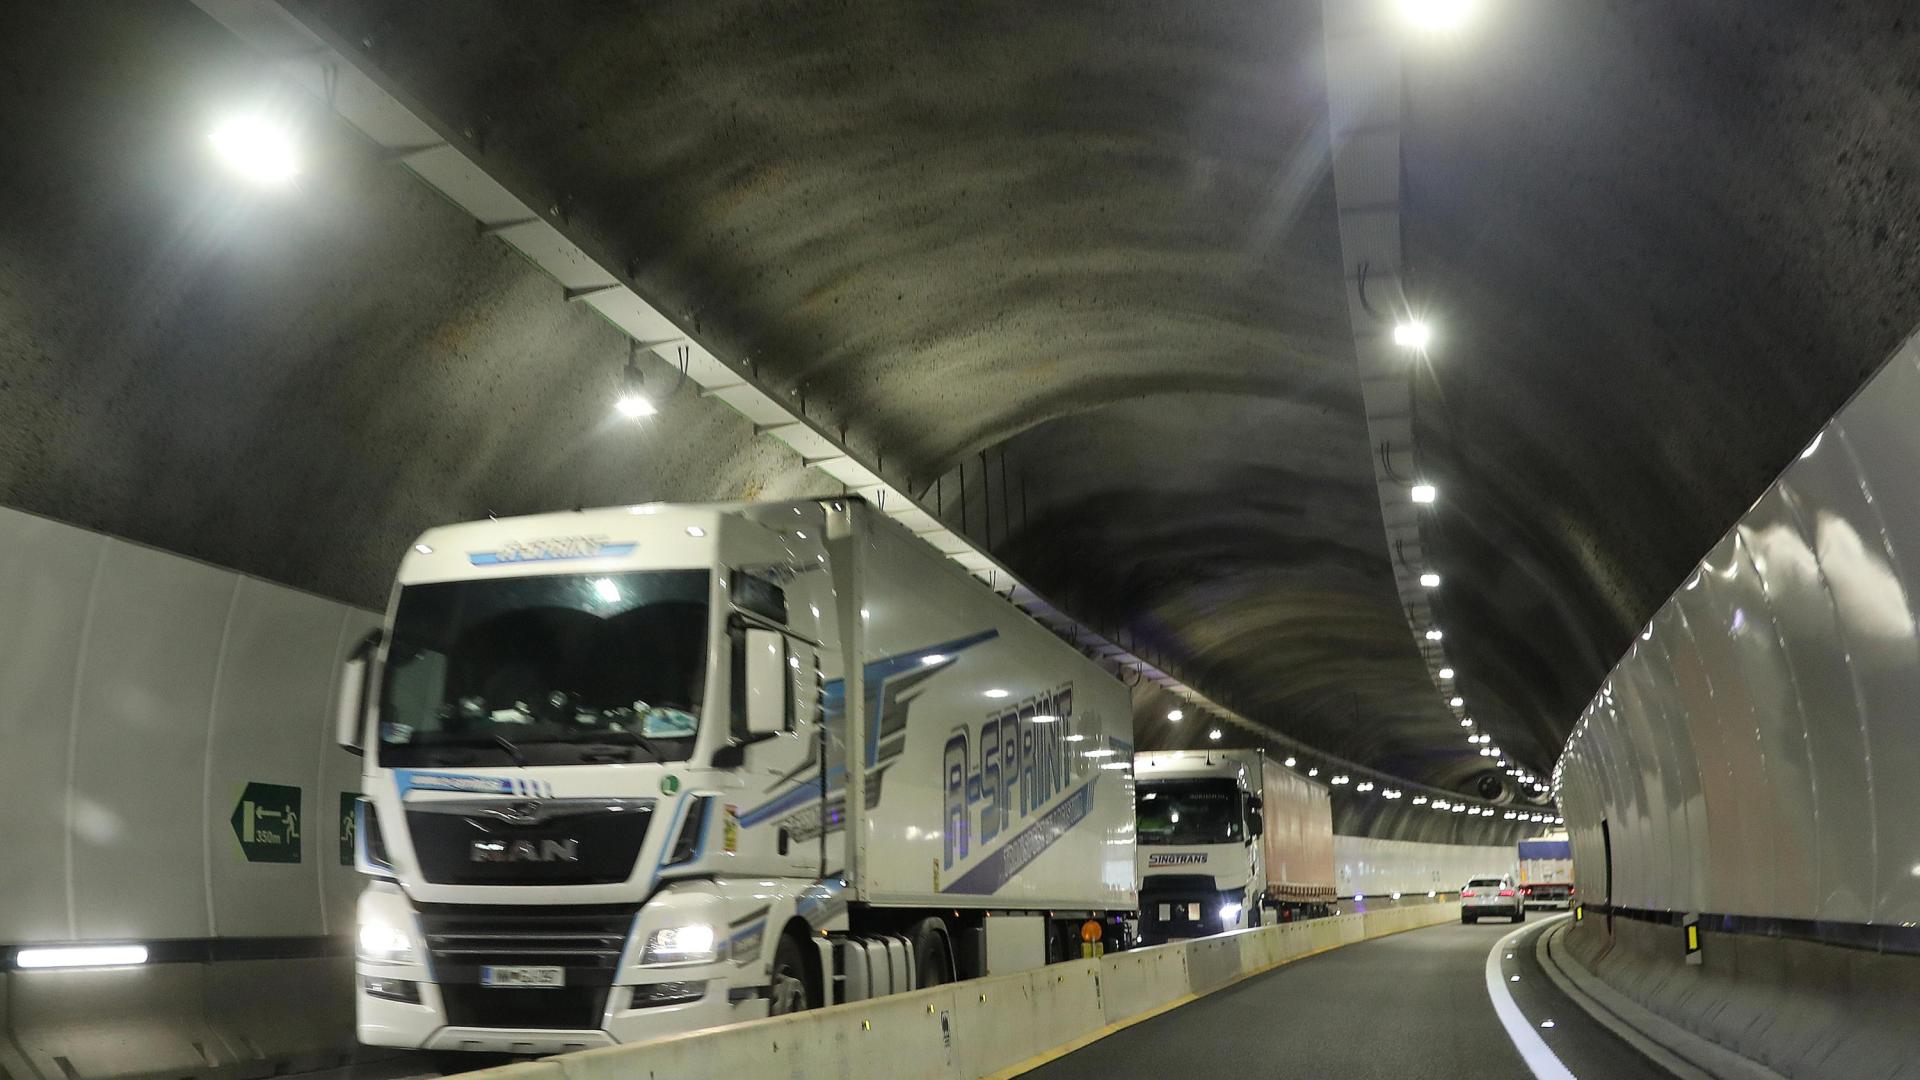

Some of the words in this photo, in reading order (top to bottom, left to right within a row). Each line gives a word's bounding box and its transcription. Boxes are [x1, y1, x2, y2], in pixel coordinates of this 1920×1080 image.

[944, 682, 1073, 871] A-SPRINT
[256, 828, 281, 844] 350m
[470, 839, 578, 862] MAN
